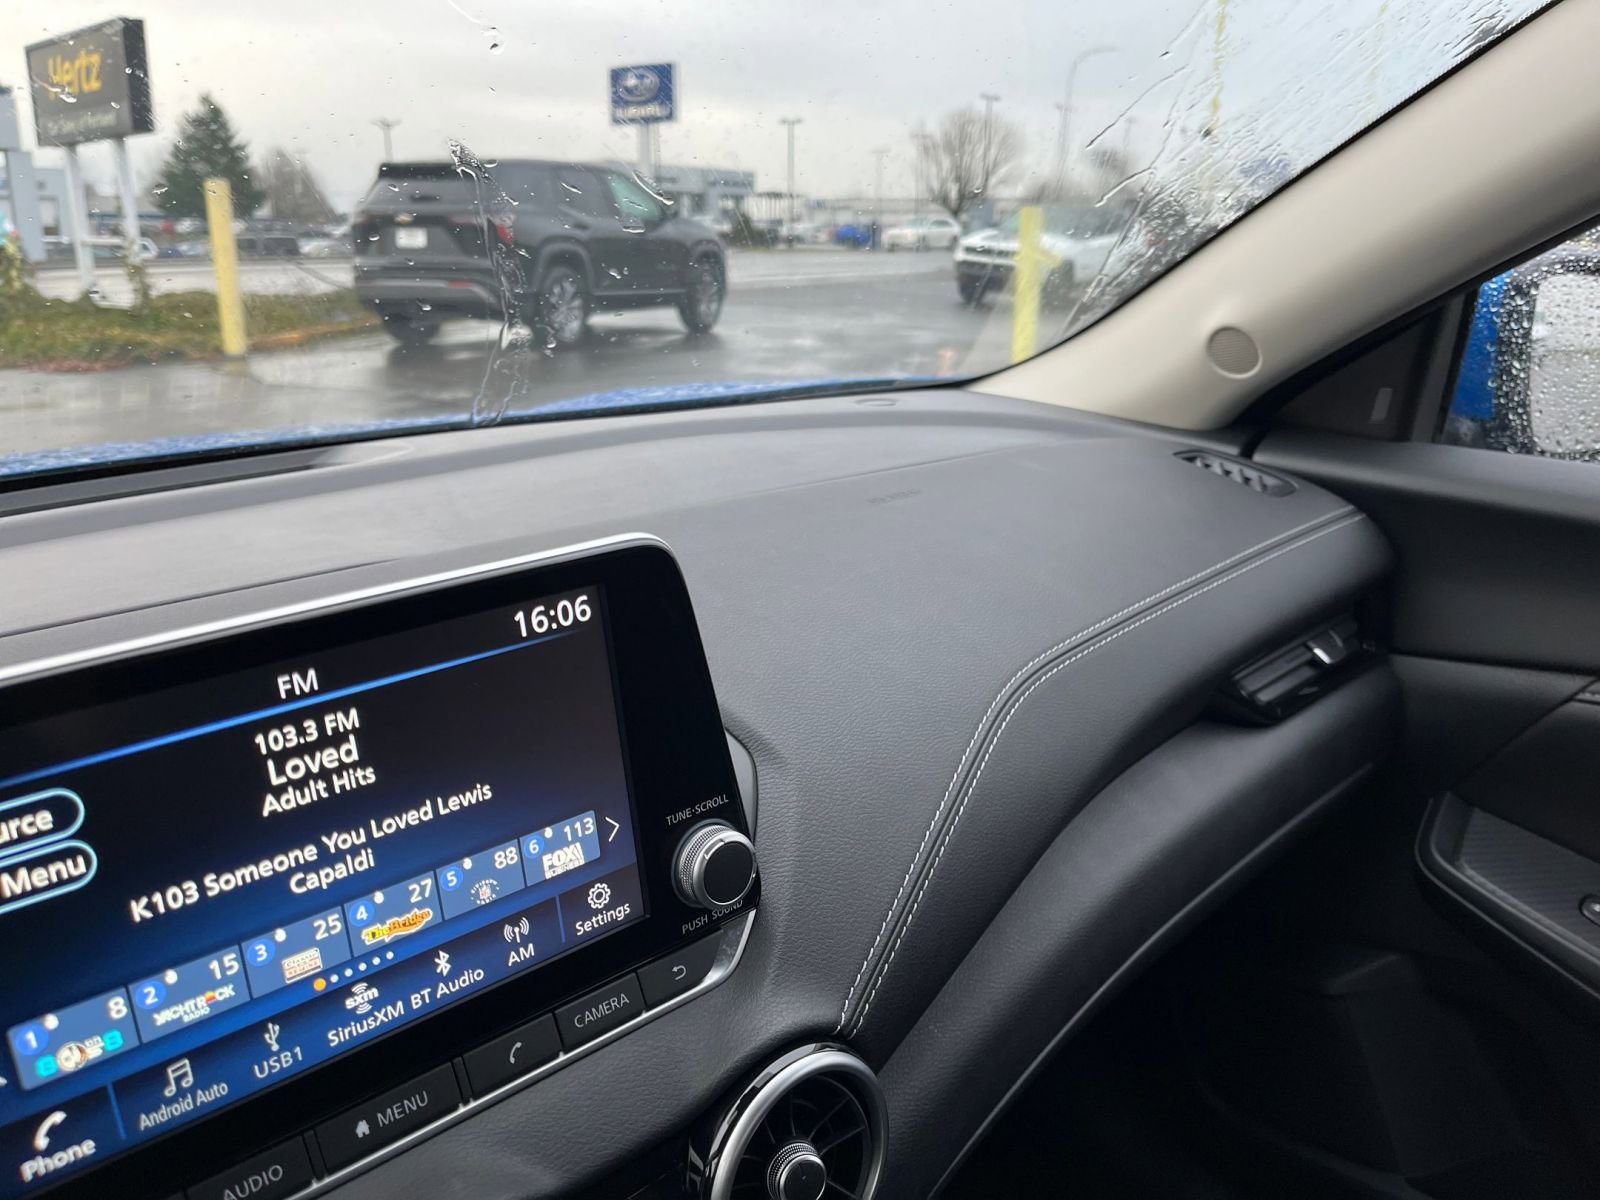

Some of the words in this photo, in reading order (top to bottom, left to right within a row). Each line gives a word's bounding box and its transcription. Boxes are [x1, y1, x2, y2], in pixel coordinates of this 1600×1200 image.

[514, 595, 592, 638] 16:06
[277, 668, 319, 699] FM
[254, 720, 319, 756] 103.3
[325, 708, 360, 737] FM
[267, 734, 360, 786] Loved
[262, 778, 328, 817] Adult
[332, 764, 376, 795] Hits
[129, 881, 200, 923] K103
[202, 843, 318, 898] Someone
[321, 826, 366, 855] You
[370, 801, 433, 841] Loved
[437, 783, 492, 816] Lewis
[529, 839, 540, 854] 6
[563, 817, 595, 843] 113
[0, 854, 87, 898] Menu
[289, 849, 375, 895] Capaldi
[447, 872, 456, 886] 5
[494, 846, 519, 870] 88
[356, 905, 369, 921] 4
[408, 878, 433, 903] 27
[575, 902, 631, 936] Settings
[255, 944, 268, 962] 3
[313, 914, 342, 941] 25
[682, 914, 708, 935] PUSH
[507, 943, 535, 967] AM
[143, 986, 159, 1006] 2
[209, 953, 240, 980] 15
[410, 987, 432, 1010] BT
[436, 967, 485, 1000] Audio
[25, 1030, 38, 1049] 1
[107, 996, 128, 1019] 8
[327, 1000, 405, 1047] SiriusXM
[573, 992, 630, 1028] CAMERA
[254, 1046, 303, 1079] USB1
[139, 1095, 194, 1131] Android
[196, 1082, 229, 1107] Auto
[376, 1090, 430, 1127] MENU
[20, 1138, 97, 1183] Phone
[223, 1164, 283, 1200] AUDIO
